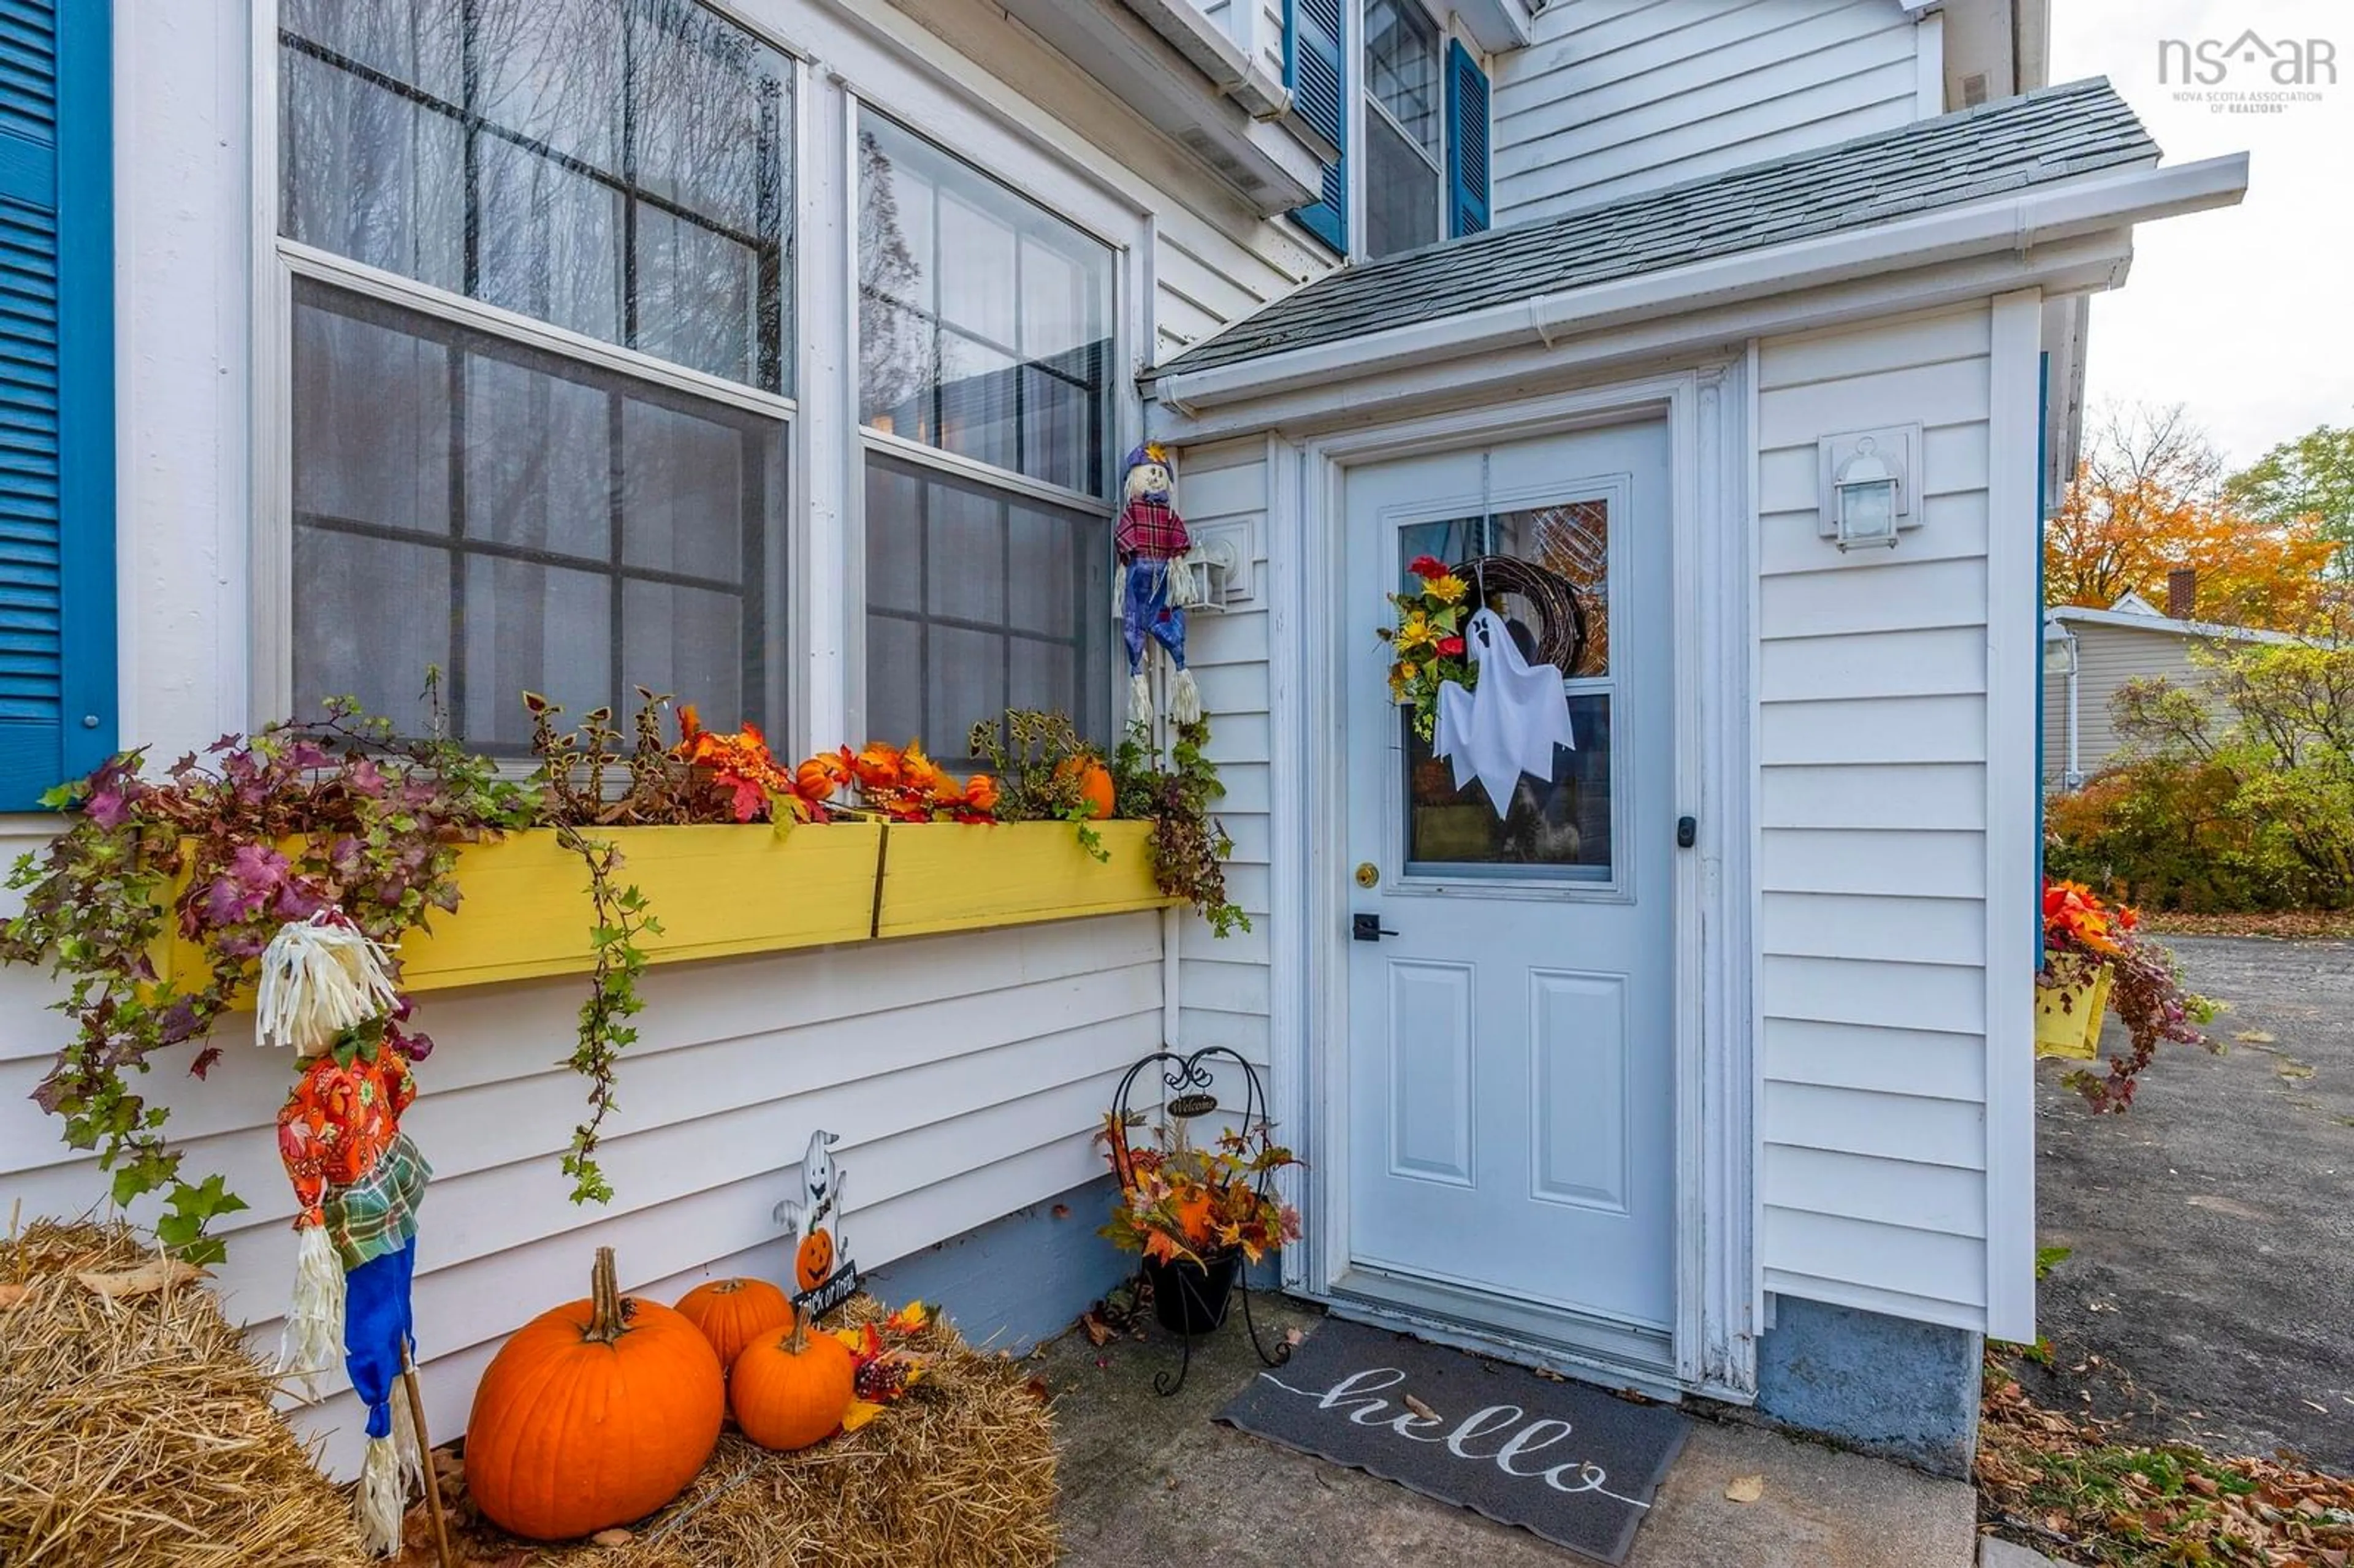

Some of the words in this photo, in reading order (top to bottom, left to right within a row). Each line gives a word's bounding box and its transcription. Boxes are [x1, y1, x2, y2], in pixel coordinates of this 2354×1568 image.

[1171, 1098, 1214, 1114] Welcome
[798, 1290, 825, 1315] ick
[825, 1285, 836, 1307] or
[1260, 1367, 1651, 1507] hello
